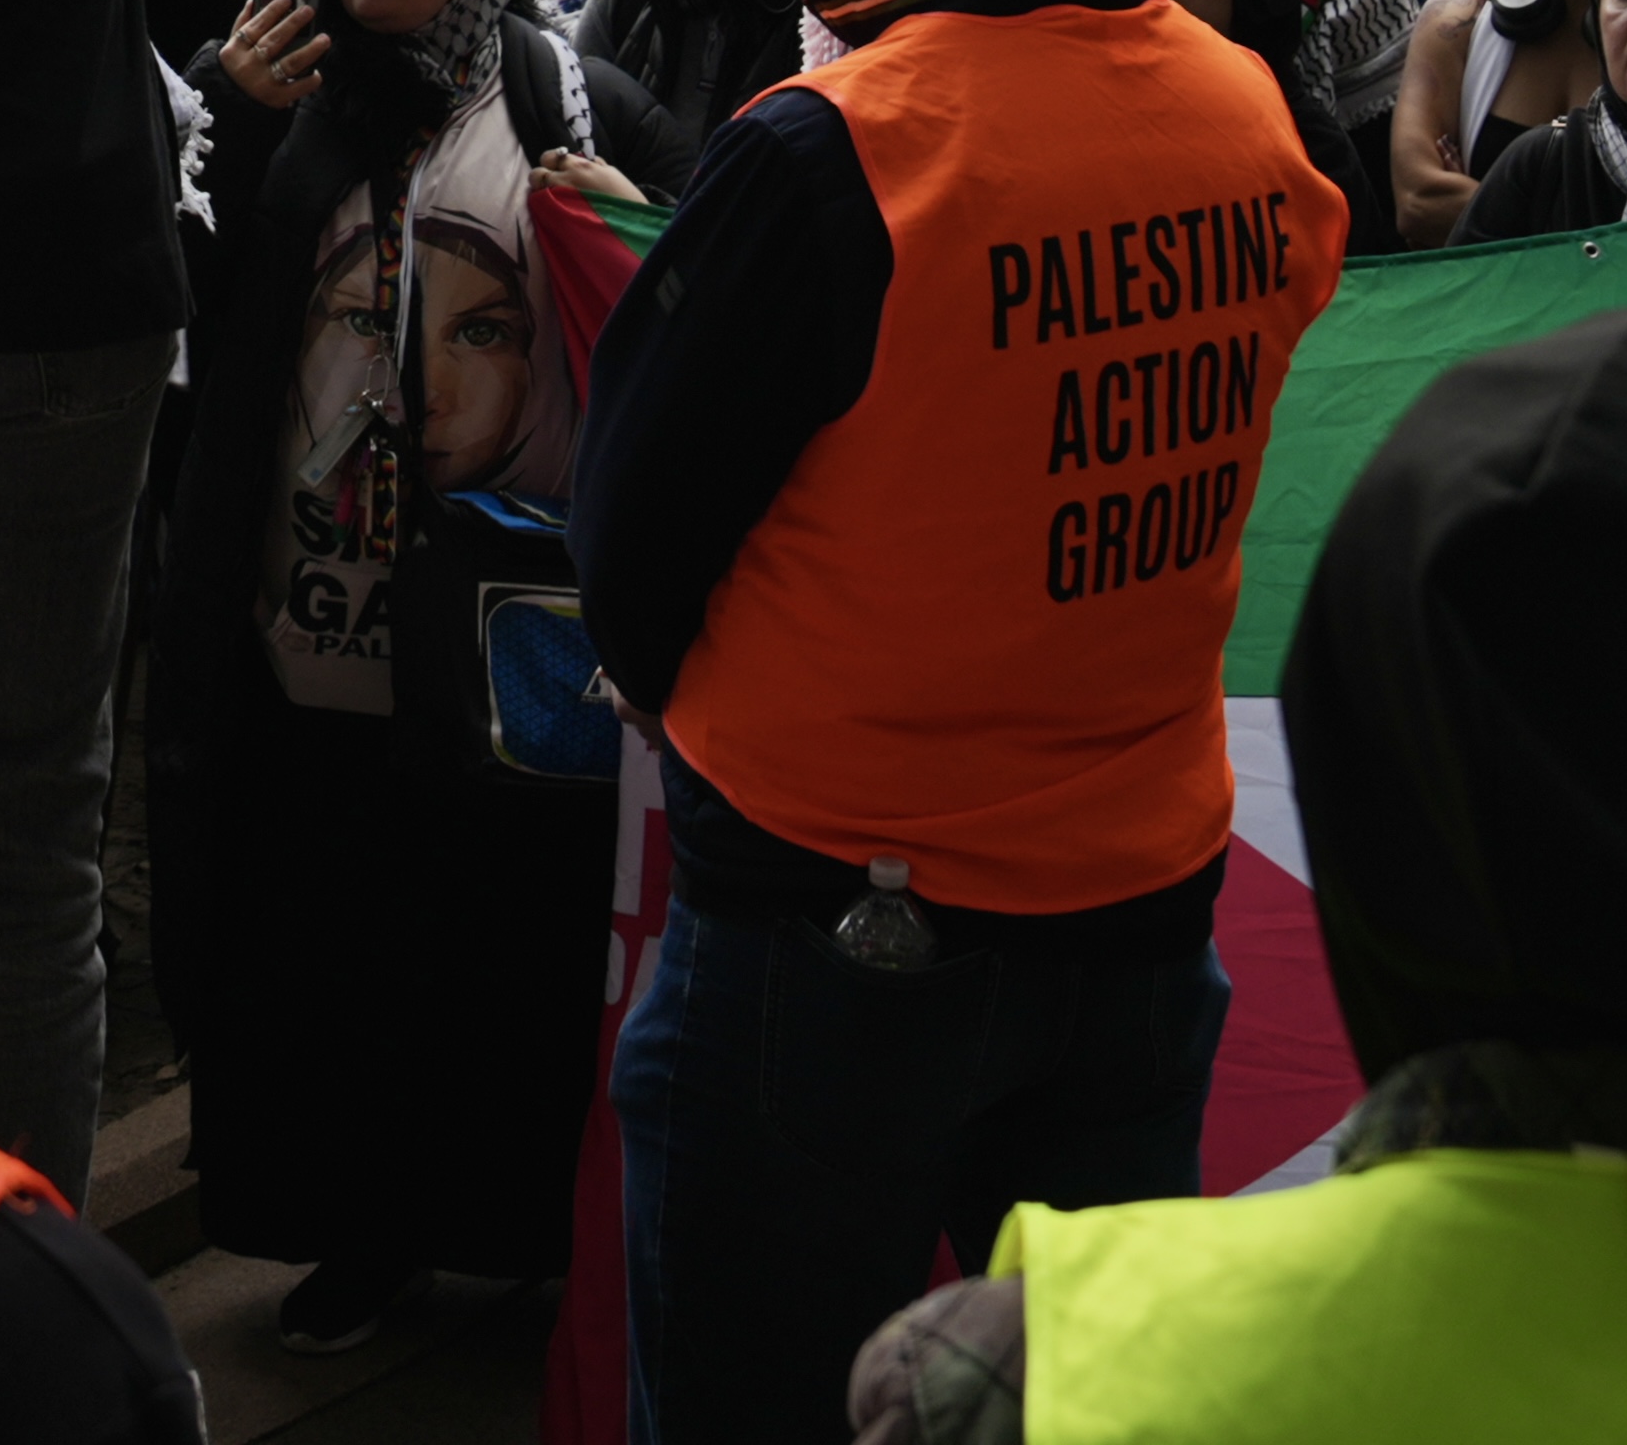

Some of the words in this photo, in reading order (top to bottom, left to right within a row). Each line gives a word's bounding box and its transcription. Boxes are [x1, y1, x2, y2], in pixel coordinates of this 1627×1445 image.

[988, 191, 1290, 350] PALESTINE
[1047, 331, 1260, 475] ACTION
[1046, 461, 1239, 603] GROUP
